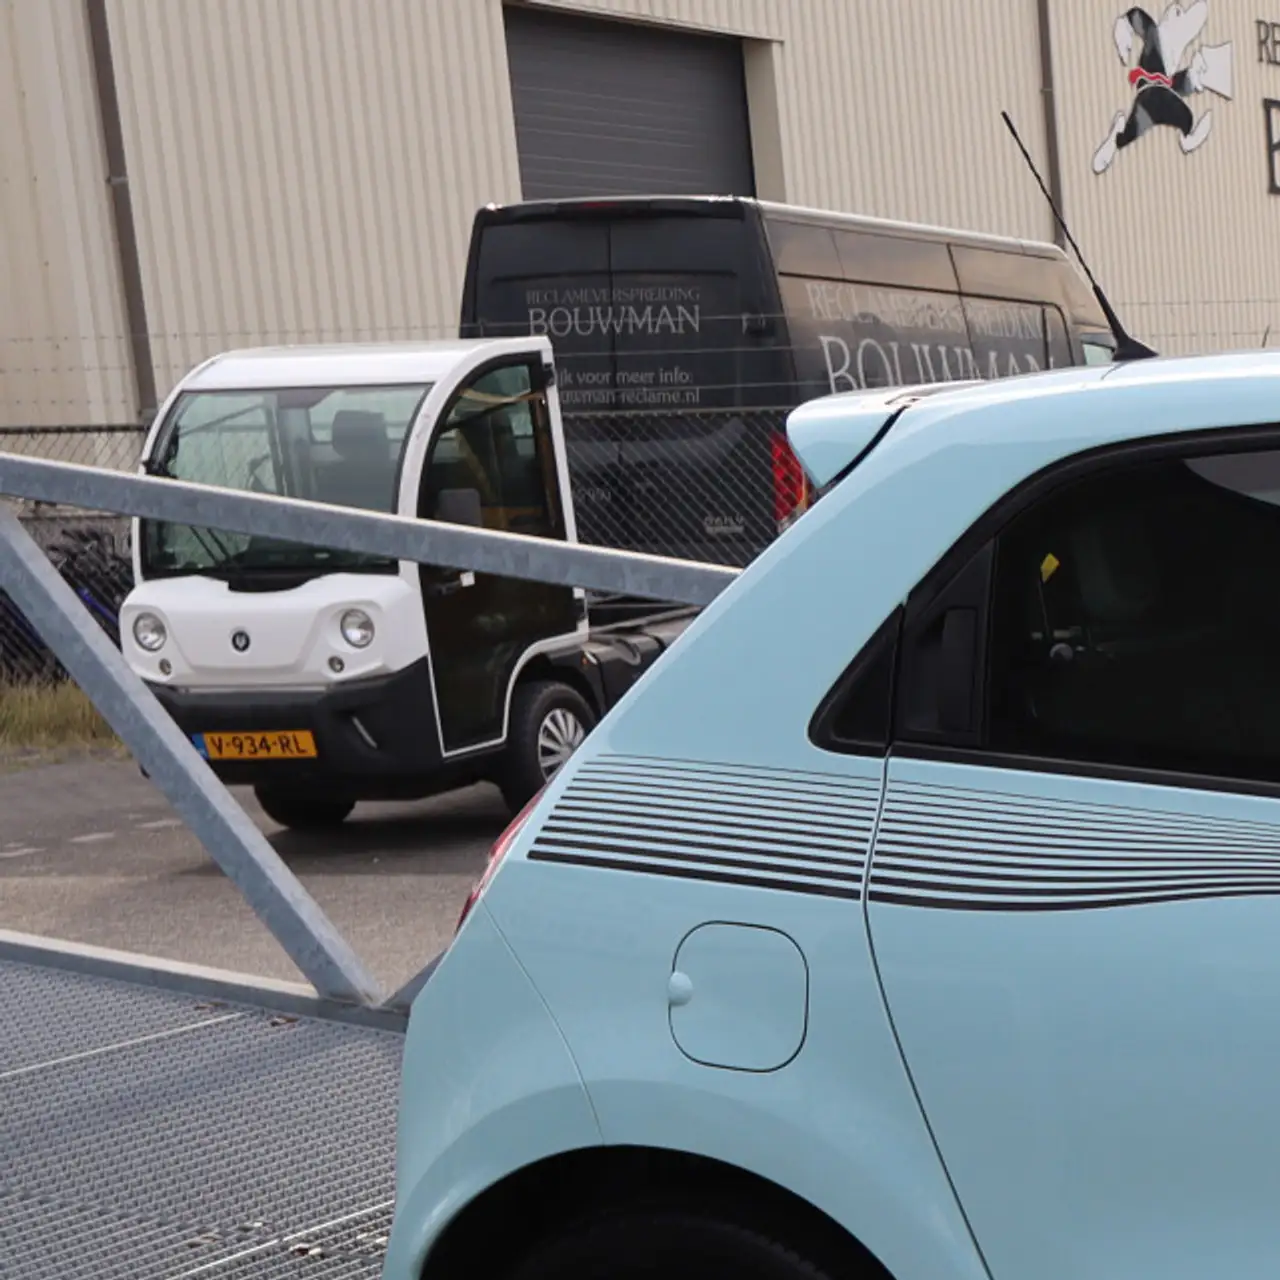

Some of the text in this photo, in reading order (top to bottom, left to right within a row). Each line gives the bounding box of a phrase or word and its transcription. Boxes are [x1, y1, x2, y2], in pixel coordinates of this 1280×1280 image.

[528, 304, 700, 337] BOUWMAN
[576, 371, 611, 384] voor
[210, 732, 308, 755] V-934-RL
